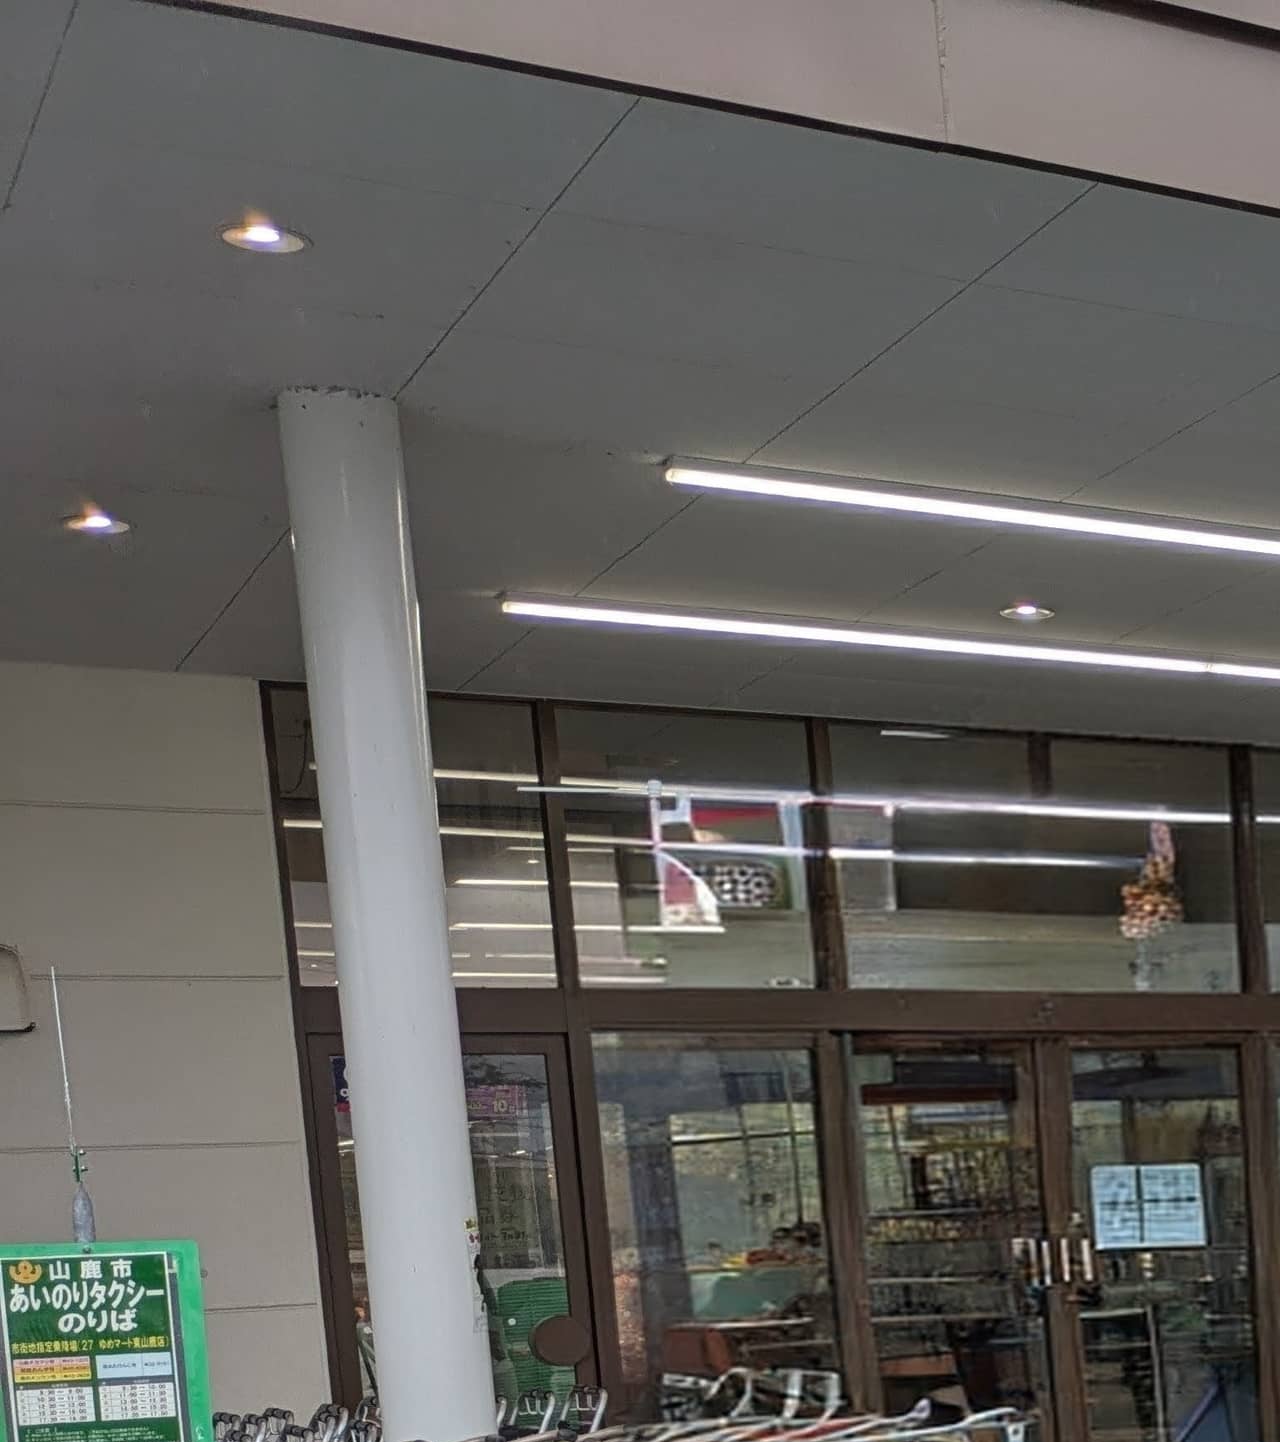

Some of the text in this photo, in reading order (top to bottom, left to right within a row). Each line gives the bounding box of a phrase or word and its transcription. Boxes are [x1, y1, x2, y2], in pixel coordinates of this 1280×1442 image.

[48, 1259, 132, 1280] 山鹿市
[9, 1281, 165, 1314] あいのりタクシー
[58, 1309, 138, 1334] のりば
